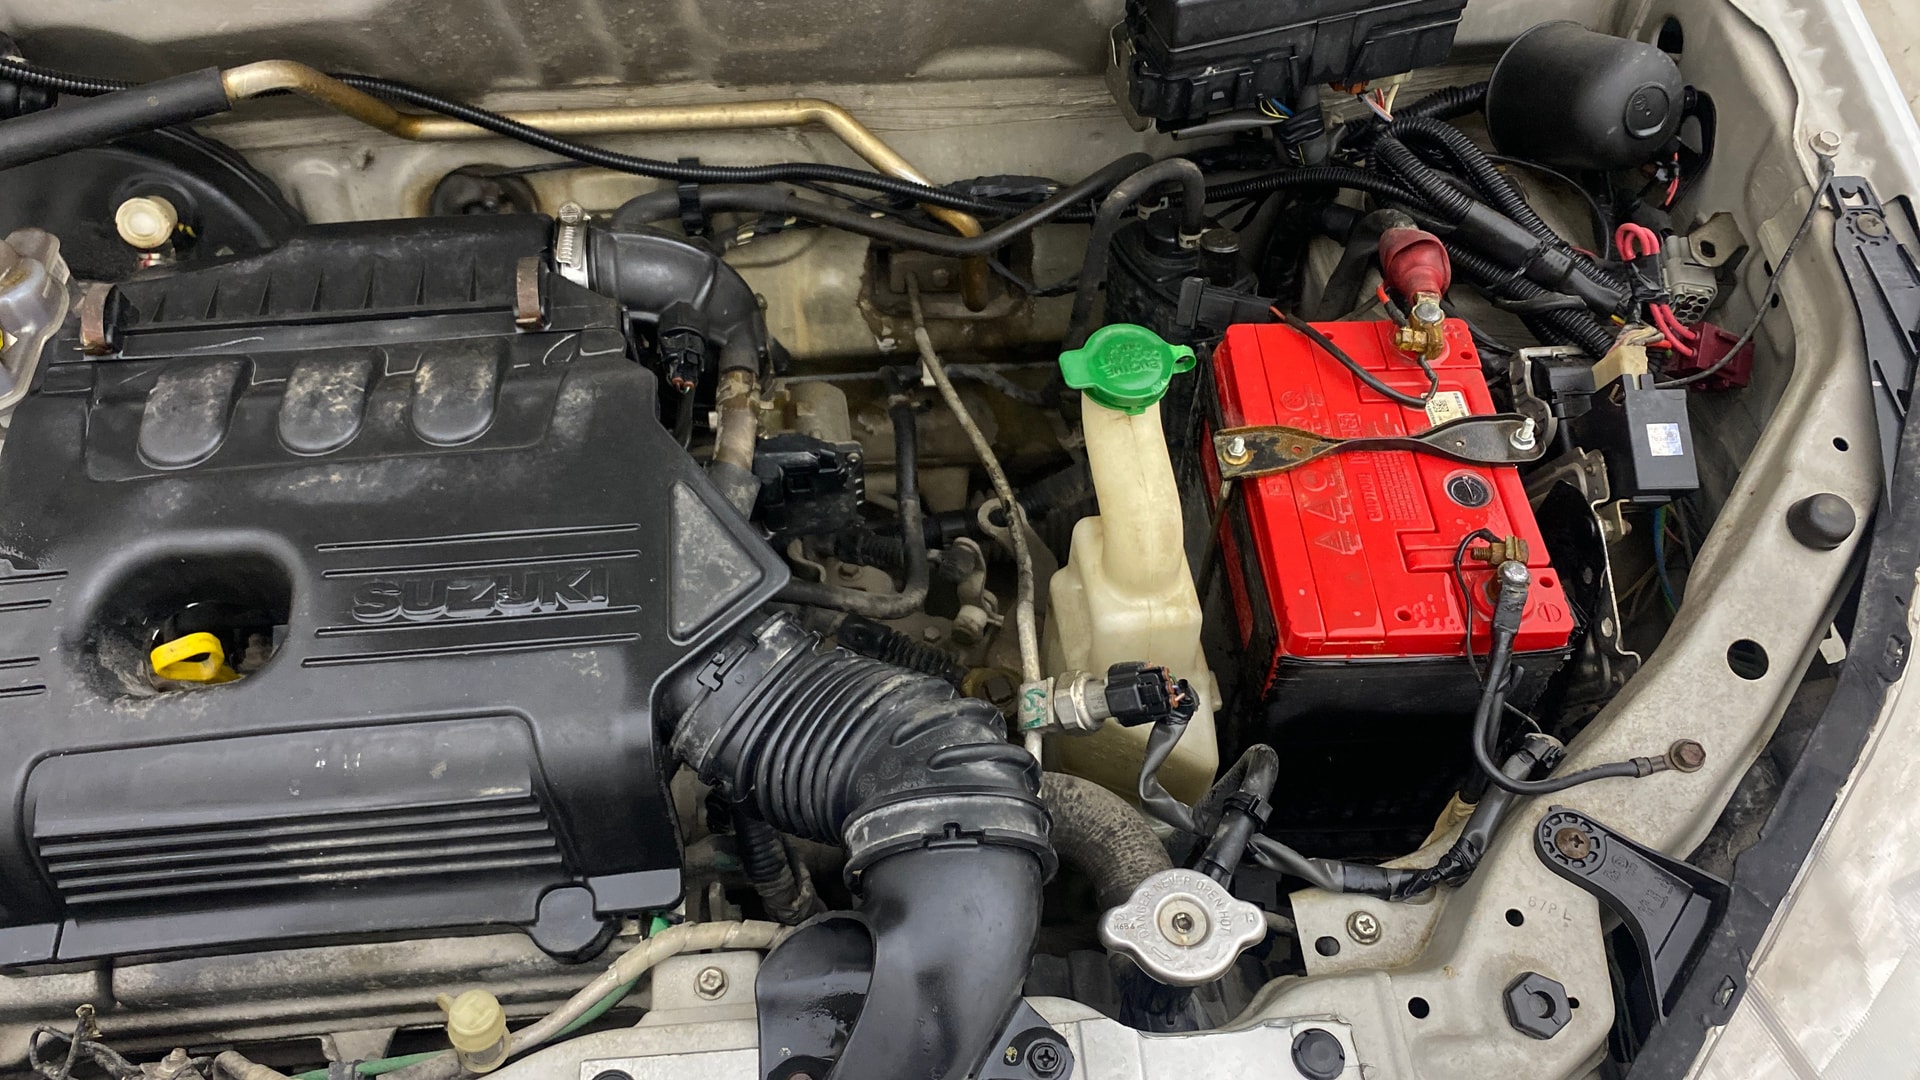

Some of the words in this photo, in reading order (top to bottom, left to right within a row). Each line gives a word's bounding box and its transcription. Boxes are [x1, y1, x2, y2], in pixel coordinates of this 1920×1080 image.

[1105, 360, 1161, 378] ENGINE
[352, 568, 609, 623] SUZUKI
[1137, 891, 1153, 939] DANGER
[1153, 875, 1192, 892] NEVER
[1196, 881, 1223, 908] OPEN
[1218, 911, 1232, 937] HOT
